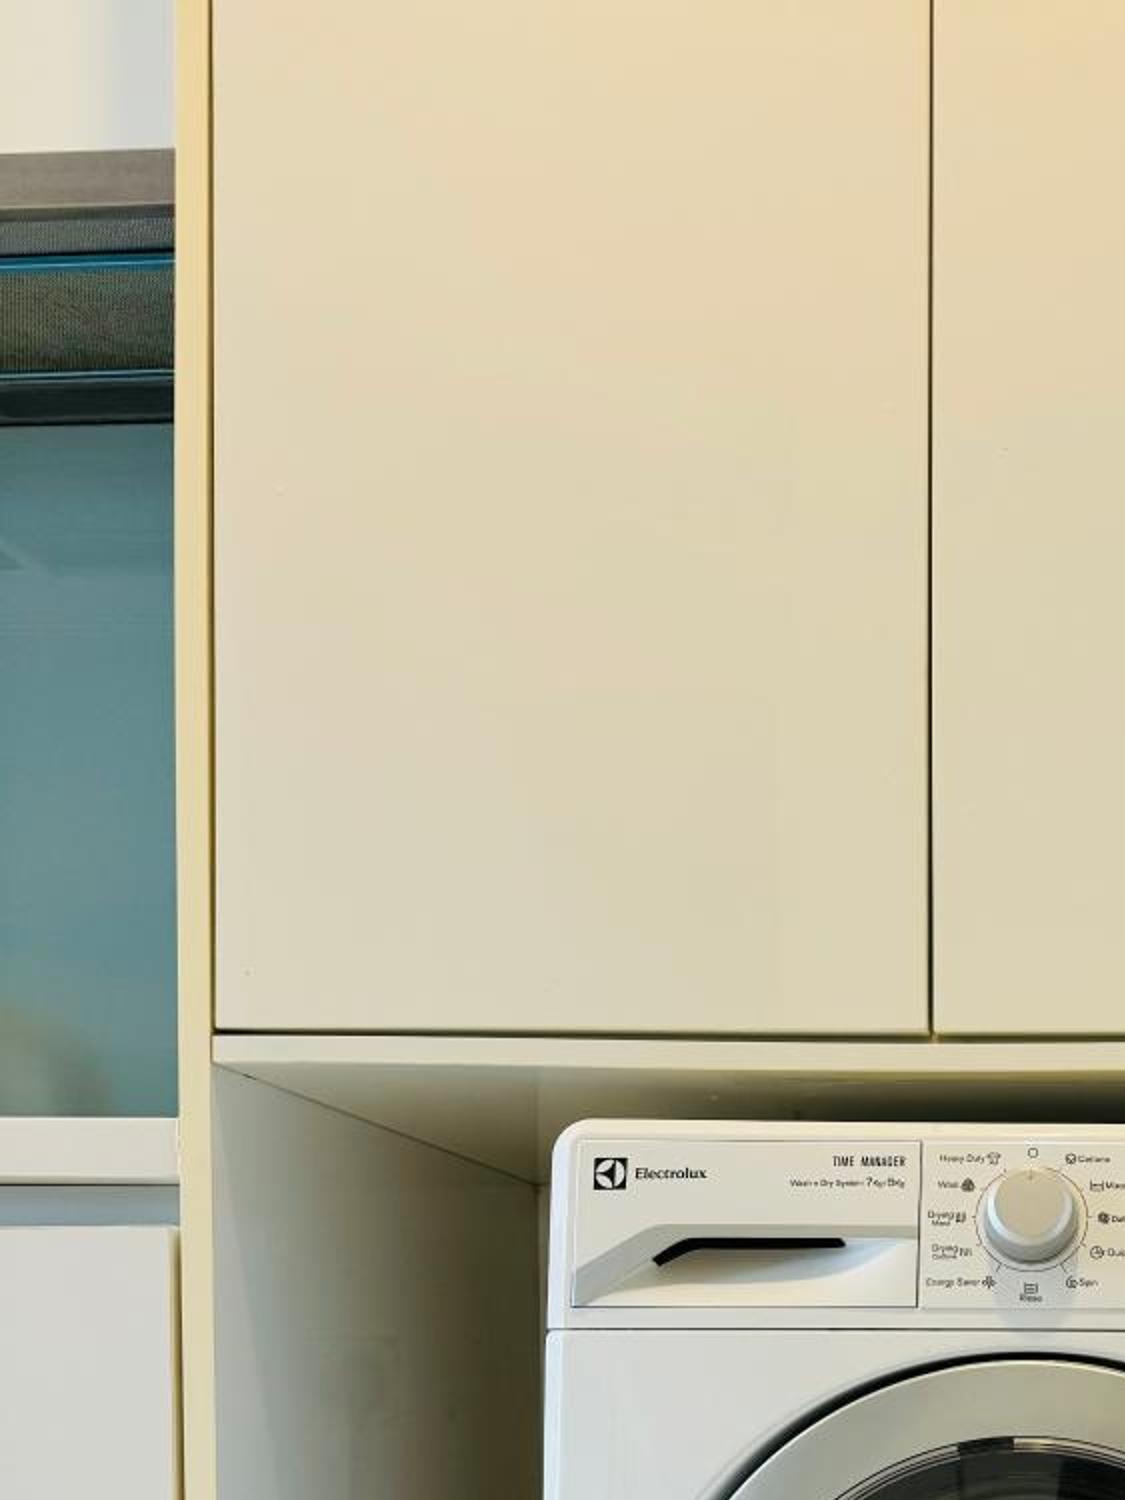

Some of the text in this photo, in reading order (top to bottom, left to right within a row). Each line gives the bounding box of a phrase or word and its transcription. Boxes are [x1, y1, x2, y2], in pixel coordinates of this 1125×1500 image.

[832, 1155, 907, 1167] TIME MANAGER
[634, 1167, 708, 1180] Electrolux
